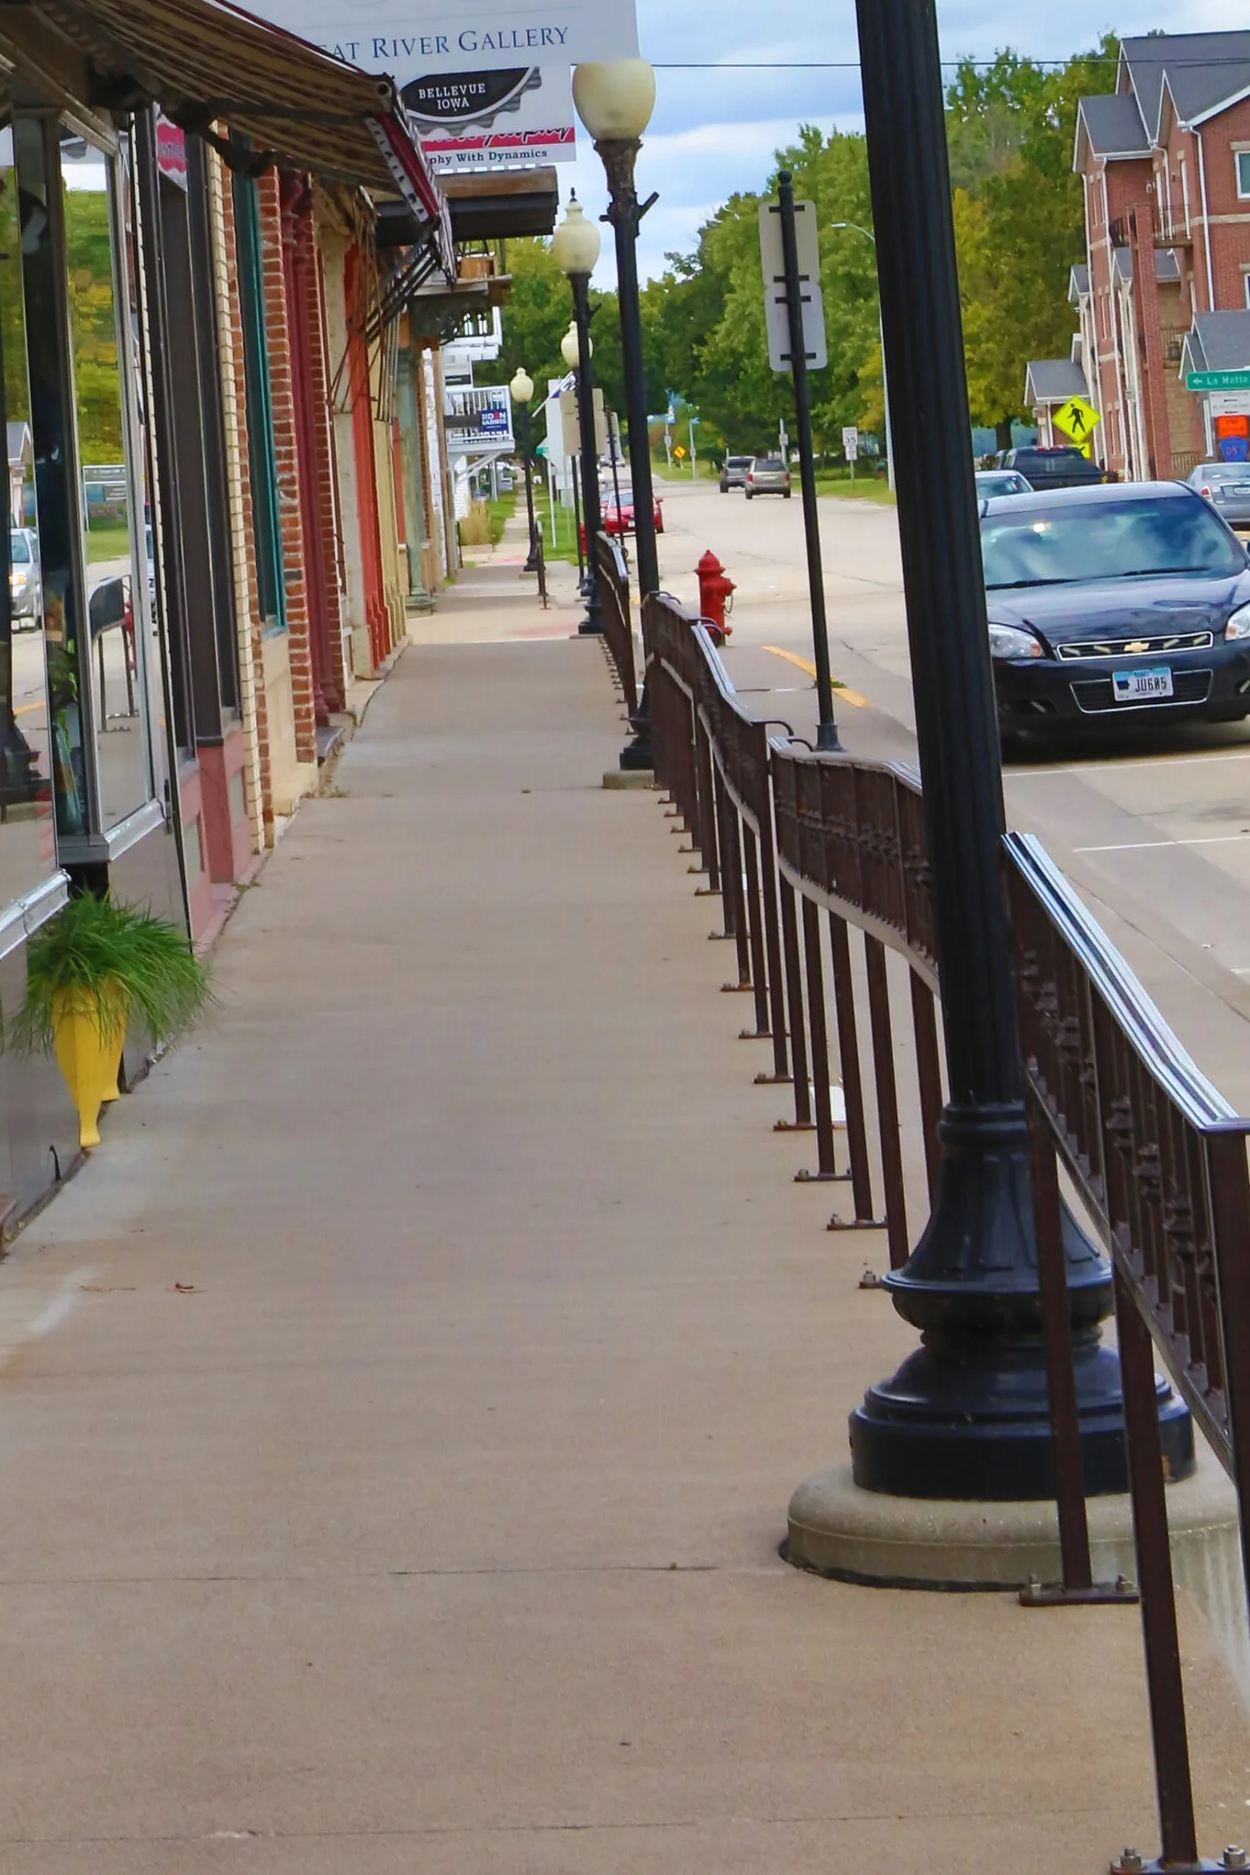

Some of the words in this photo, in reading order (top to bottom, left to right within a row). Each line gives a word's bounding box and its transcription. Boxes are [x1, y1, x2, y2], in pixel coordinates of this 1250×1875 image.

[372, 35, 450, 59] RIVER
[458, 26, 569, 52] GALLERY
[418, 82, 487, 100] BELLEVUE
[436, 97, 470, 110] IOWA
[456, 151, 484, 163] With
[488, 148, 548, 163] Dynamics
[1206, 377, 1218, 385] La
[1222, 375, 1249, 385] Motte
